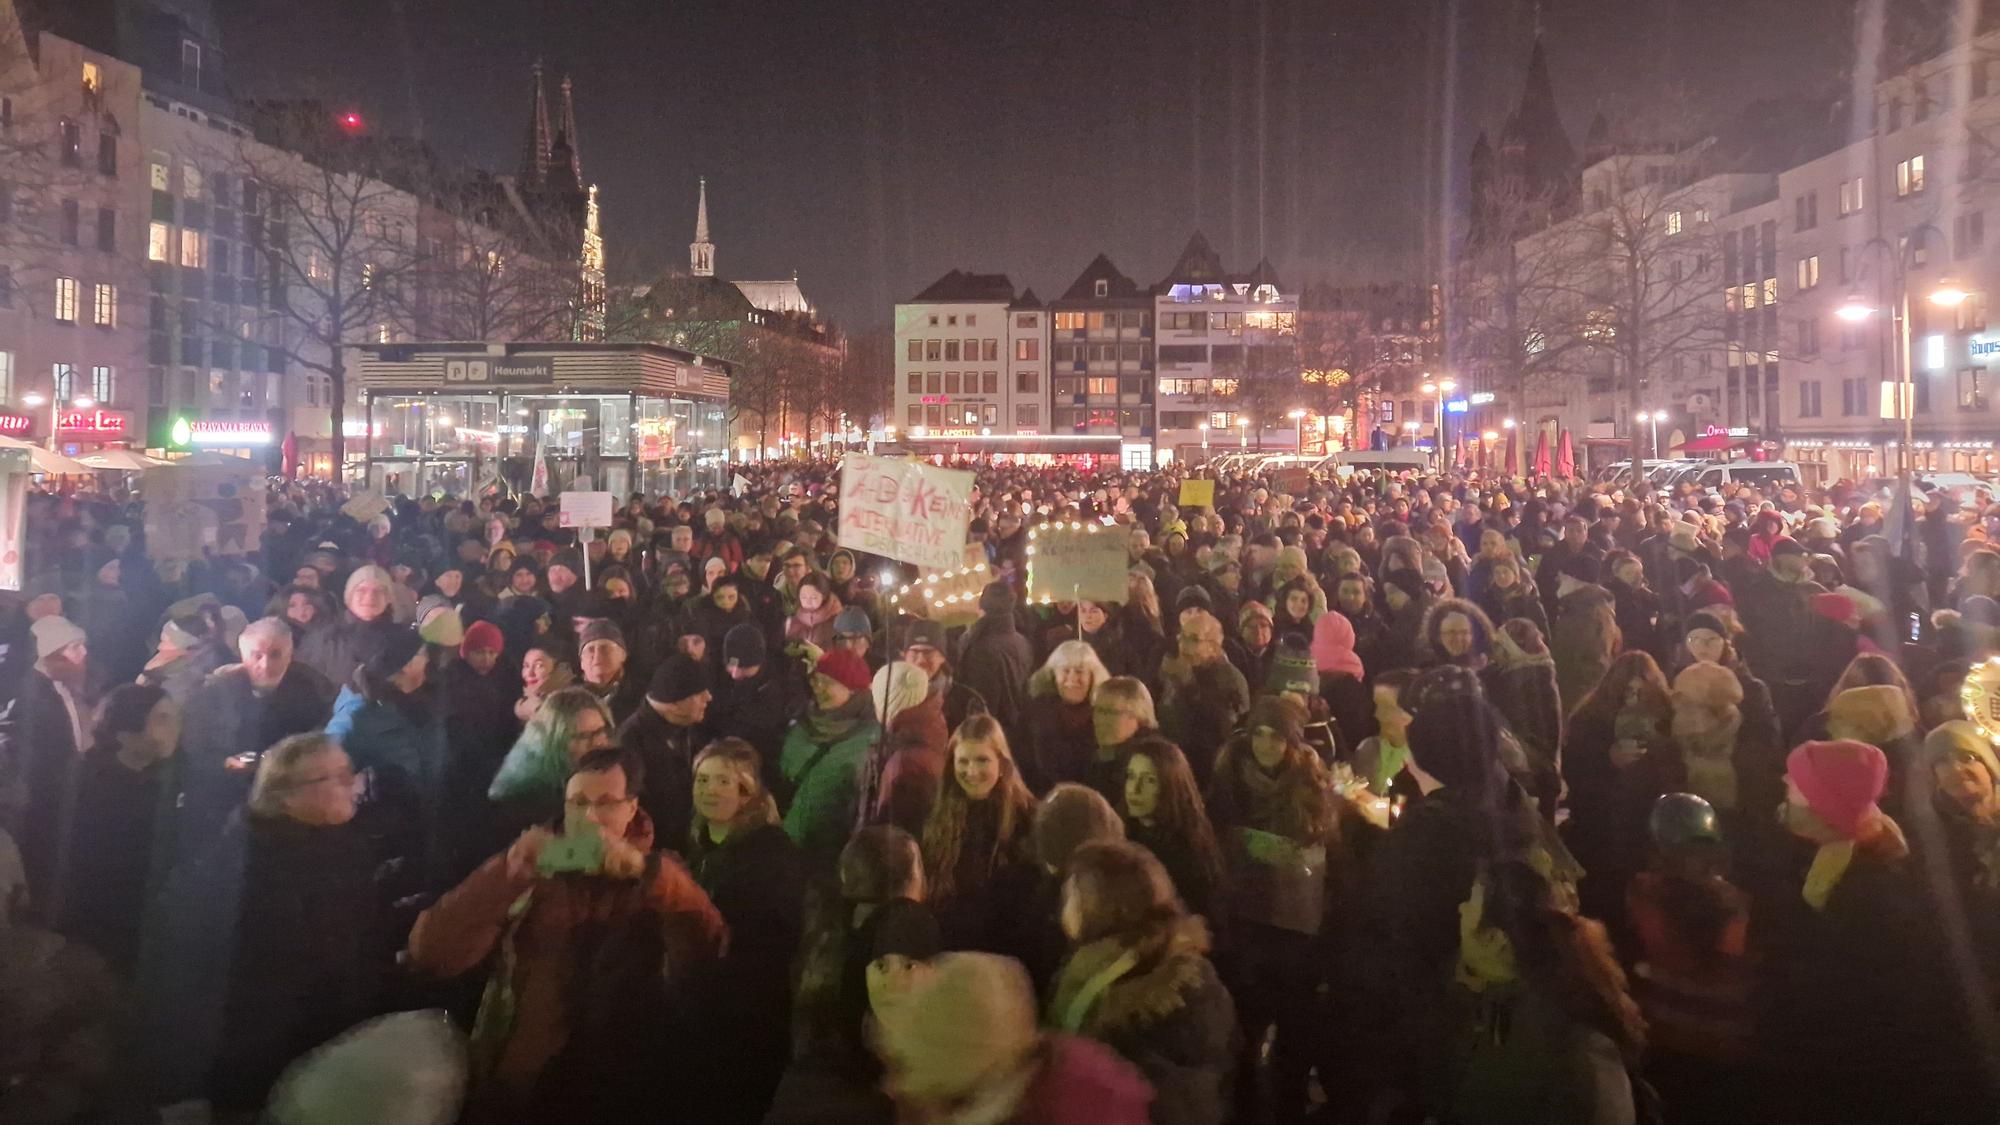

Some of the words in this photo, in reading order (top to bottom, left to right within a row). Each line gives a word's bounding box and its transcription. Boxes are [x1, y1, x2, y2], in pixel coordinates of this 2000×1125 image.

[495, 366, 547, 376] Heumarkt
[191, 422, 237, 433] SARAVANAA
[239, 422, 271, 433] BHAVAN
[943, 429, 977, 437] APOSTEL
[1016, 429, 1038, 437] HOTEL
